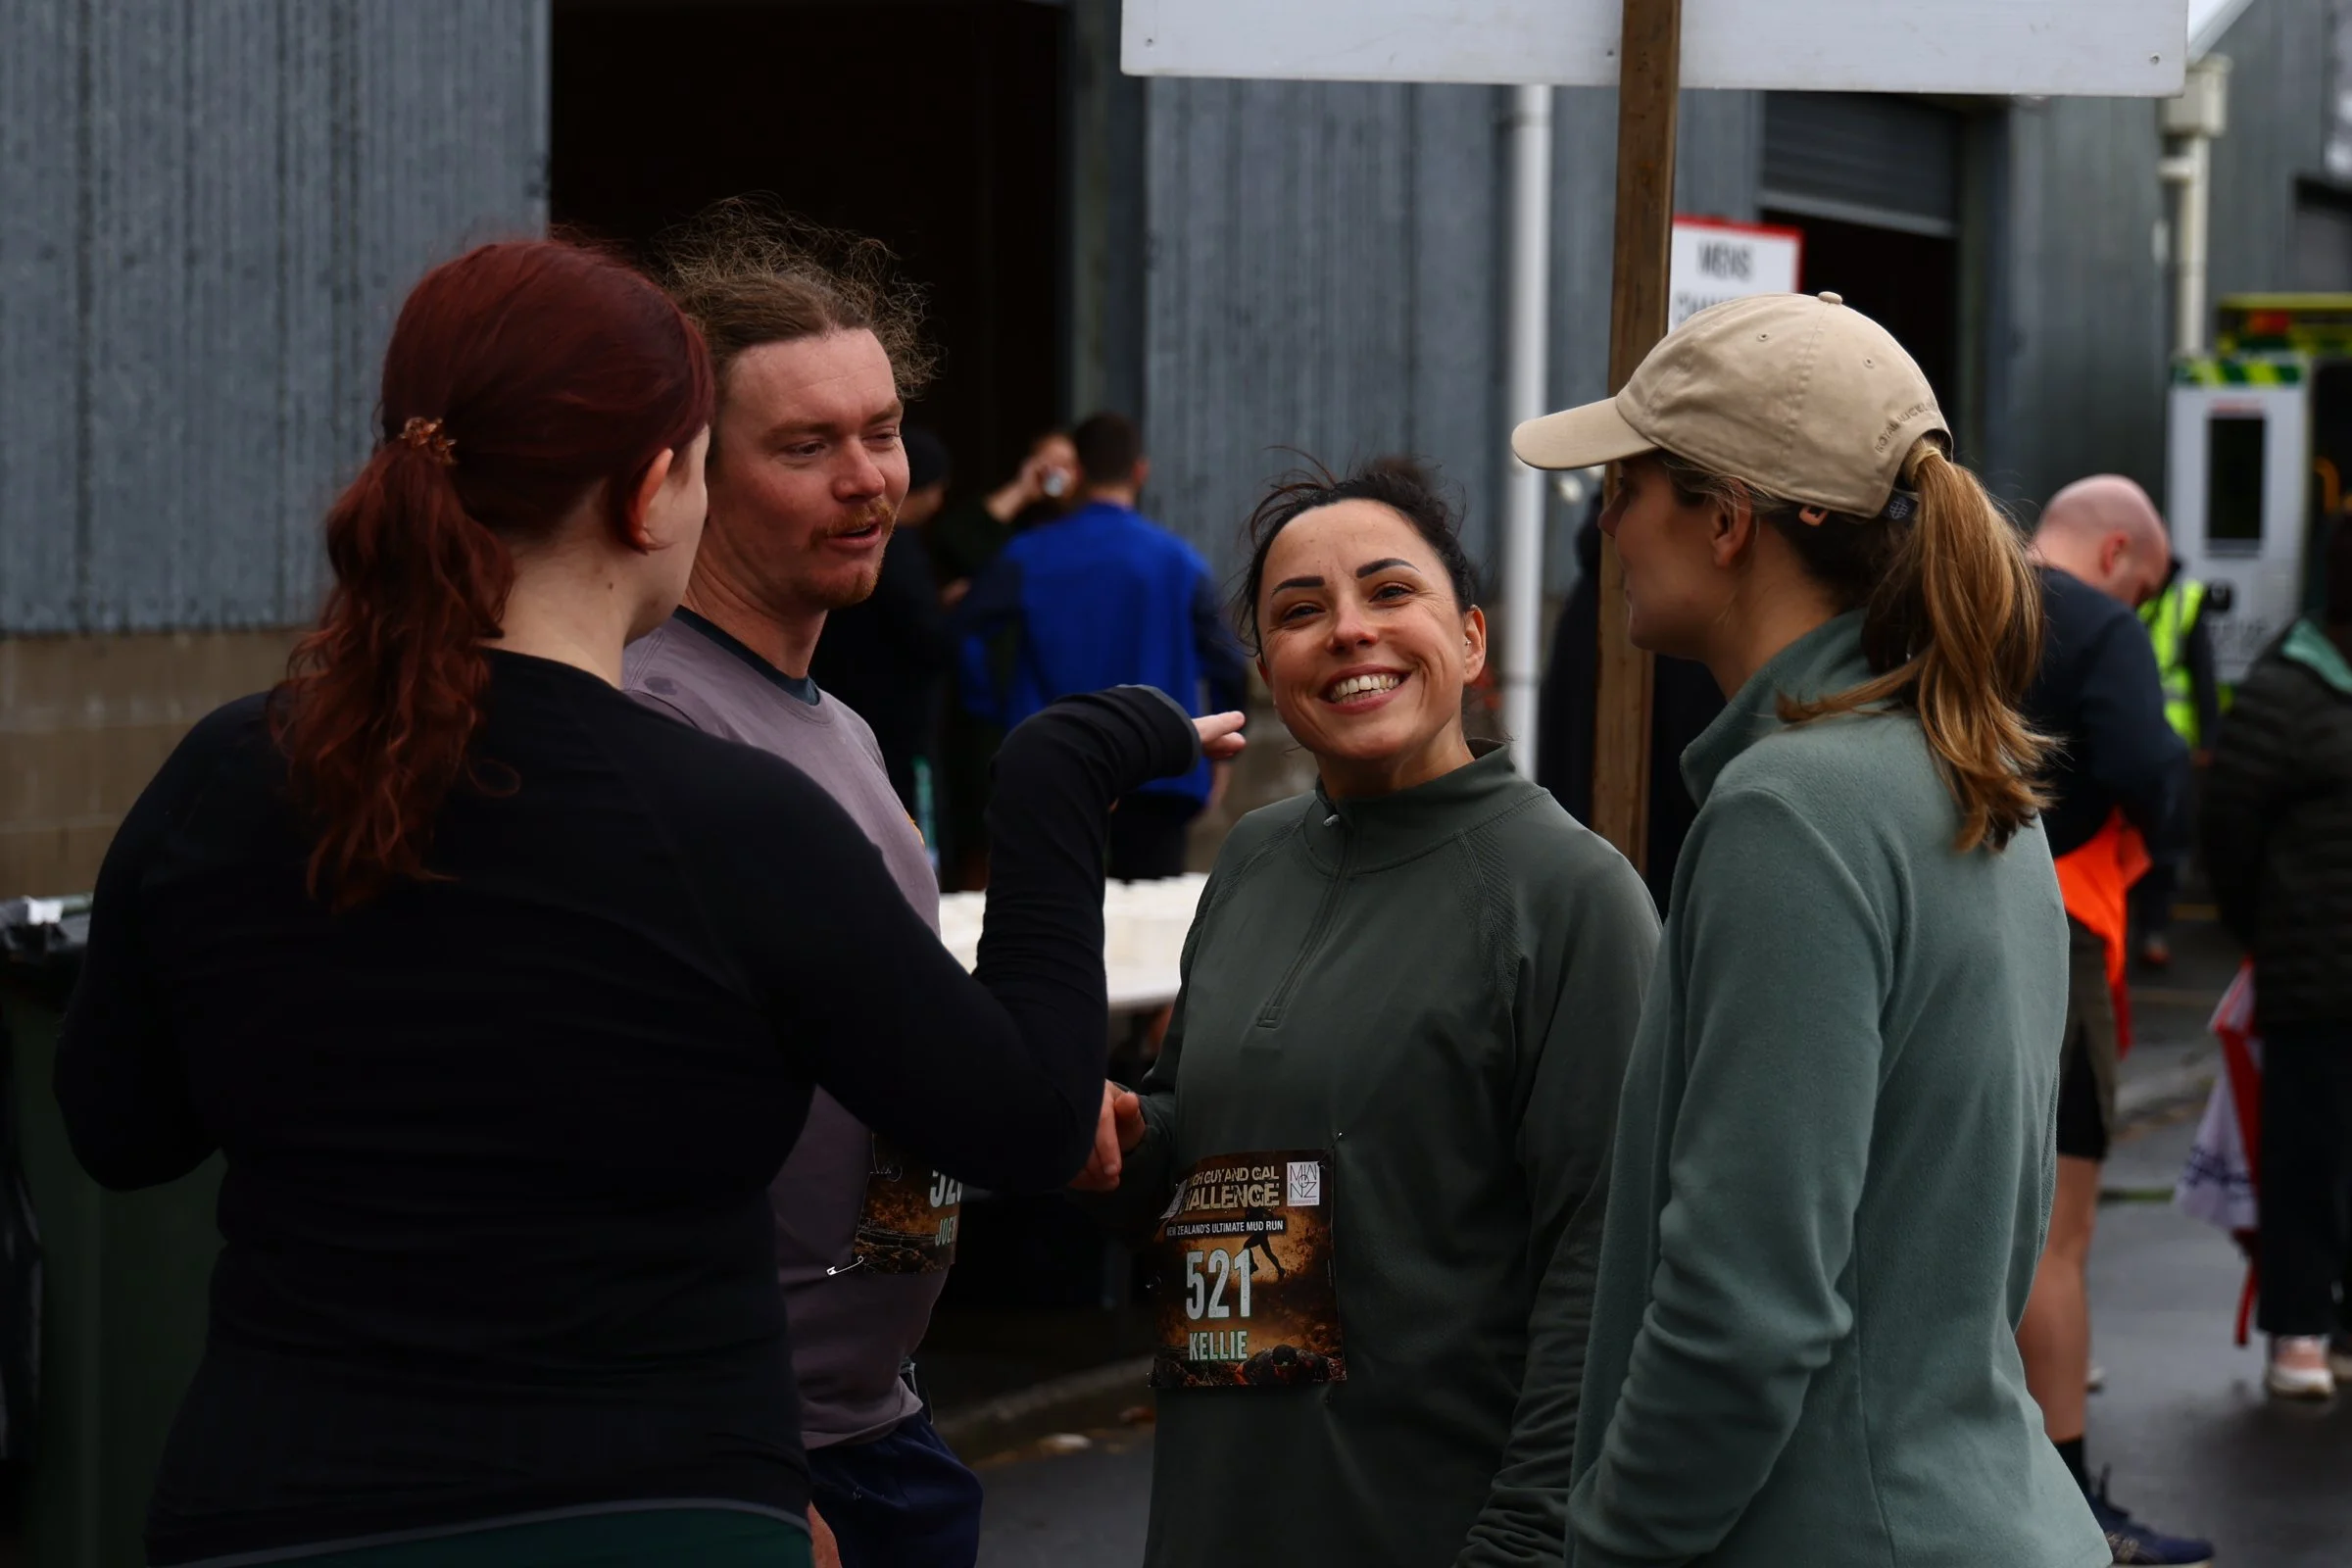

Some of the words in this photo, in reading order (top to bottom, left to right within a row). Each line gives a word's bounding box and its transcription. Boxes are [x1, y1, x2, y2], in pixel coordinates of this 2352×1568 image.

[1204, 1169, 1225, 1184] GUY
[1225, 1166, 1250, 1182] AND
[1251, 1165, 1280, 1181] GAL
[1177, 1223, 1211, 1236] ZEALAND'S
[1211, 1221, 1245, 1234] ULTIMATE
[1246, 1220, 1264, 1232] MUD
[1265, 1219, 1284, 1231] RUN
[1186, 1249, 1250, 1320] 521
[1189, 1330, 1249, 1361] KELLIE
